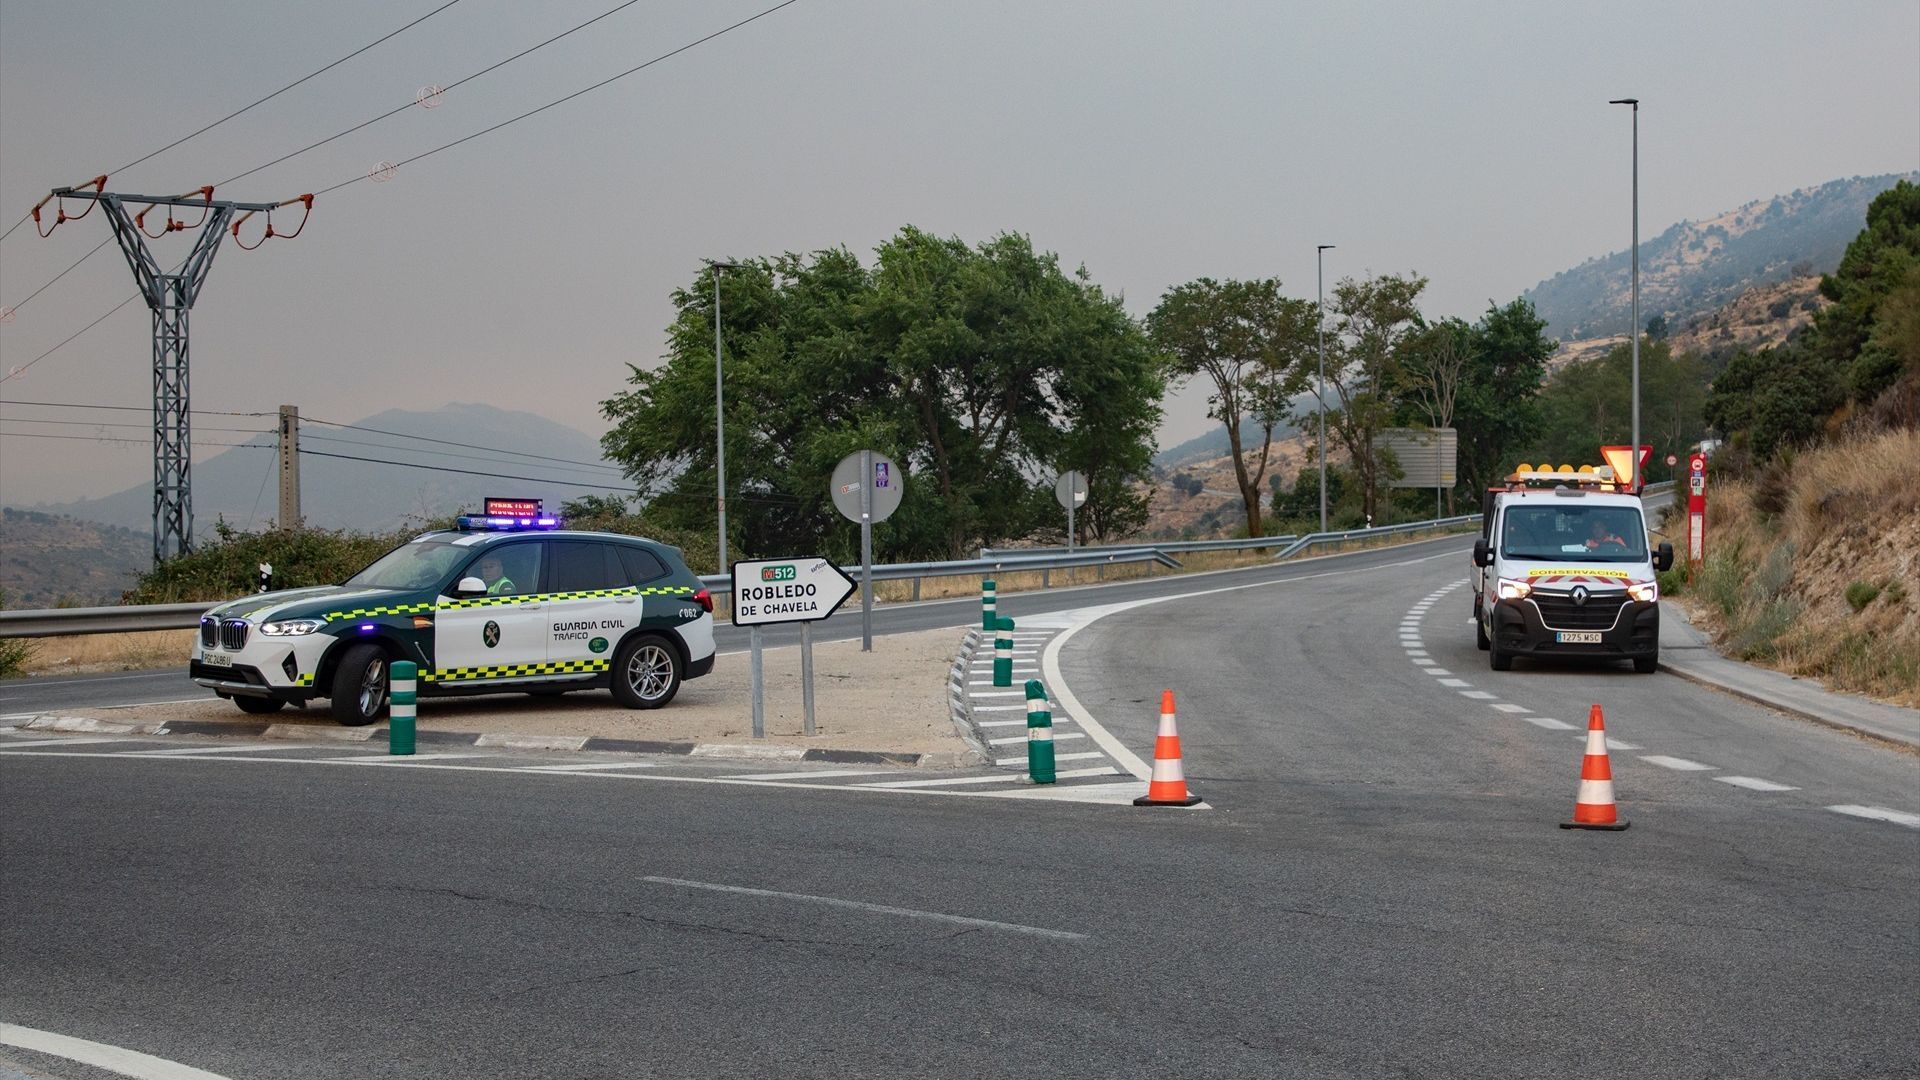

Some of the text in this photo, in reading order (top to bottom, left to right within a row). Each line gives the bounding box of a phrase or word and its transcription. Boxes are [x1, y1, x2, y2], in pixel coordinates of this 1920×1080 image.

[741, 583, 816, 601] ROBLEDO
[741, 601, 818, 616] DE CHAVELA
[553, 619, 625, 631] GUARDIA CIVIL
[1562, 633, 1599, 642] 1275 MSC
